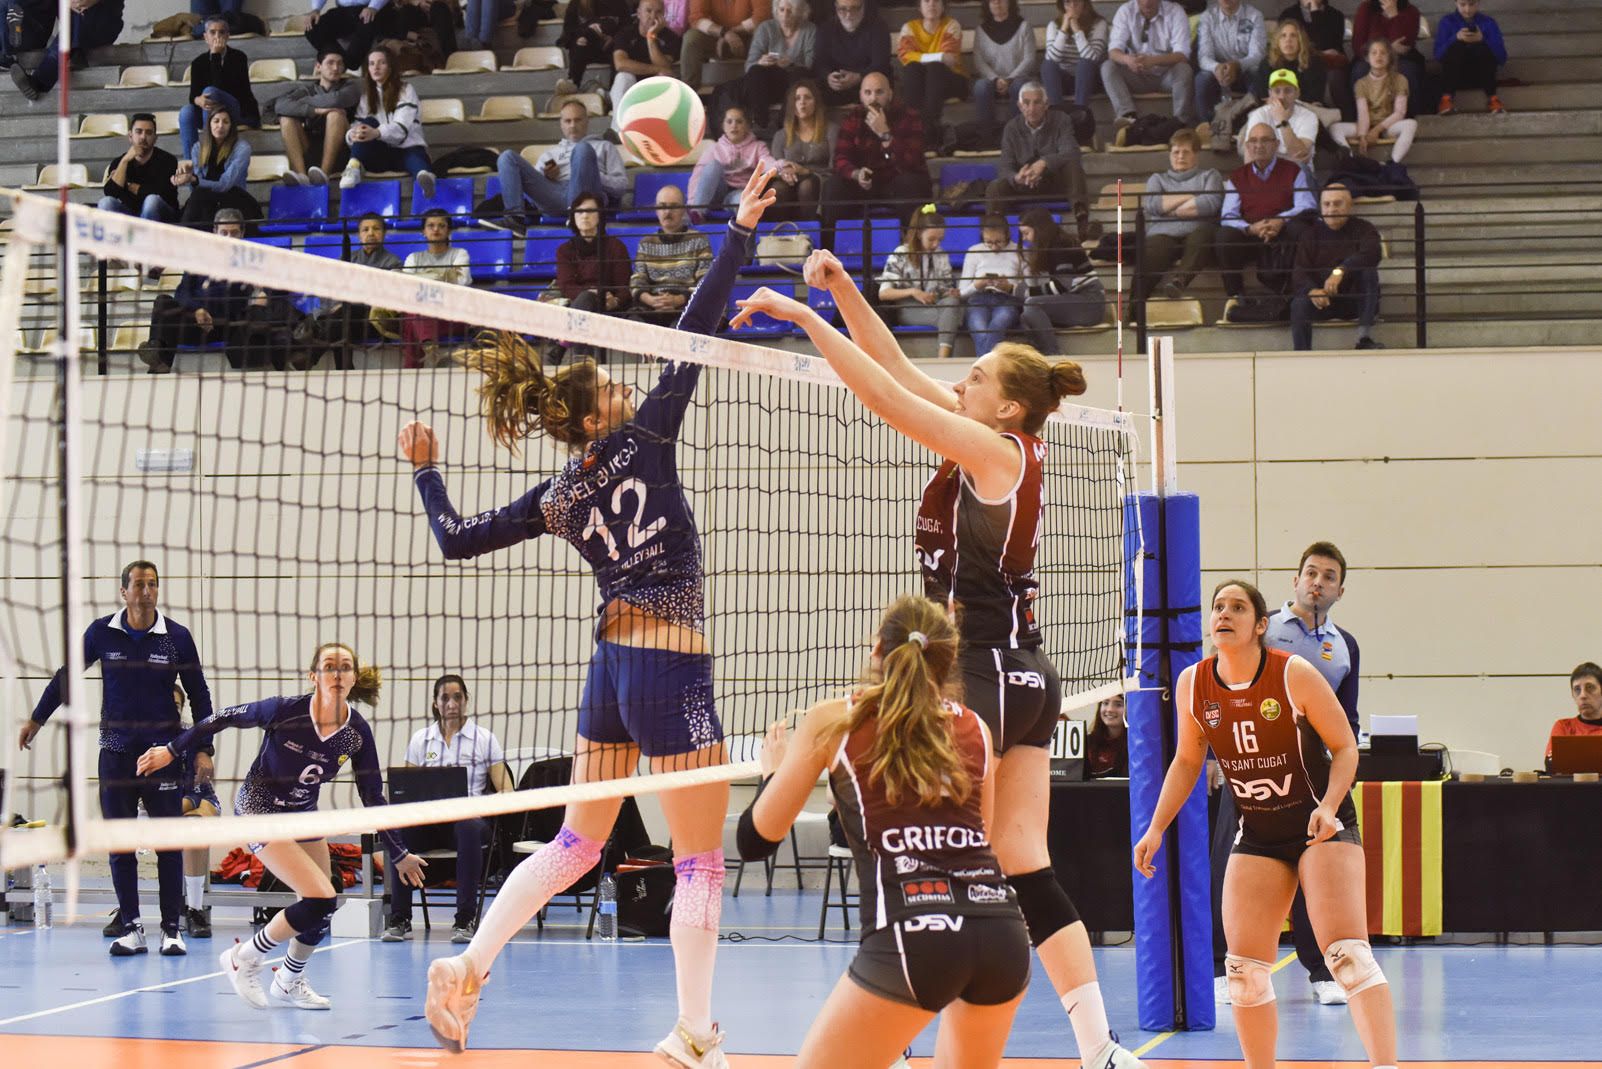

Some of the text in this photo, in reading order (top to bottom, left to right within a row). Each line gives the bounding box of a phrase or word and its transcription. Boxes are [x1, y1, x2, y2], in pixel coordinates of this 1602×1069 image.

[582, 477, 667, 561] 12
[1008, 671, 1046, 690] DSV
[1232, 720, 1259, 754] 16
[1231, 759, 1255, 772] SANT
[1257, 752, 1288, 769] CUGAT
[298, 763, 324, 785] 6
[1230, 773, 1293, 801] DSV
[904, 914, 964, 932] DSV
